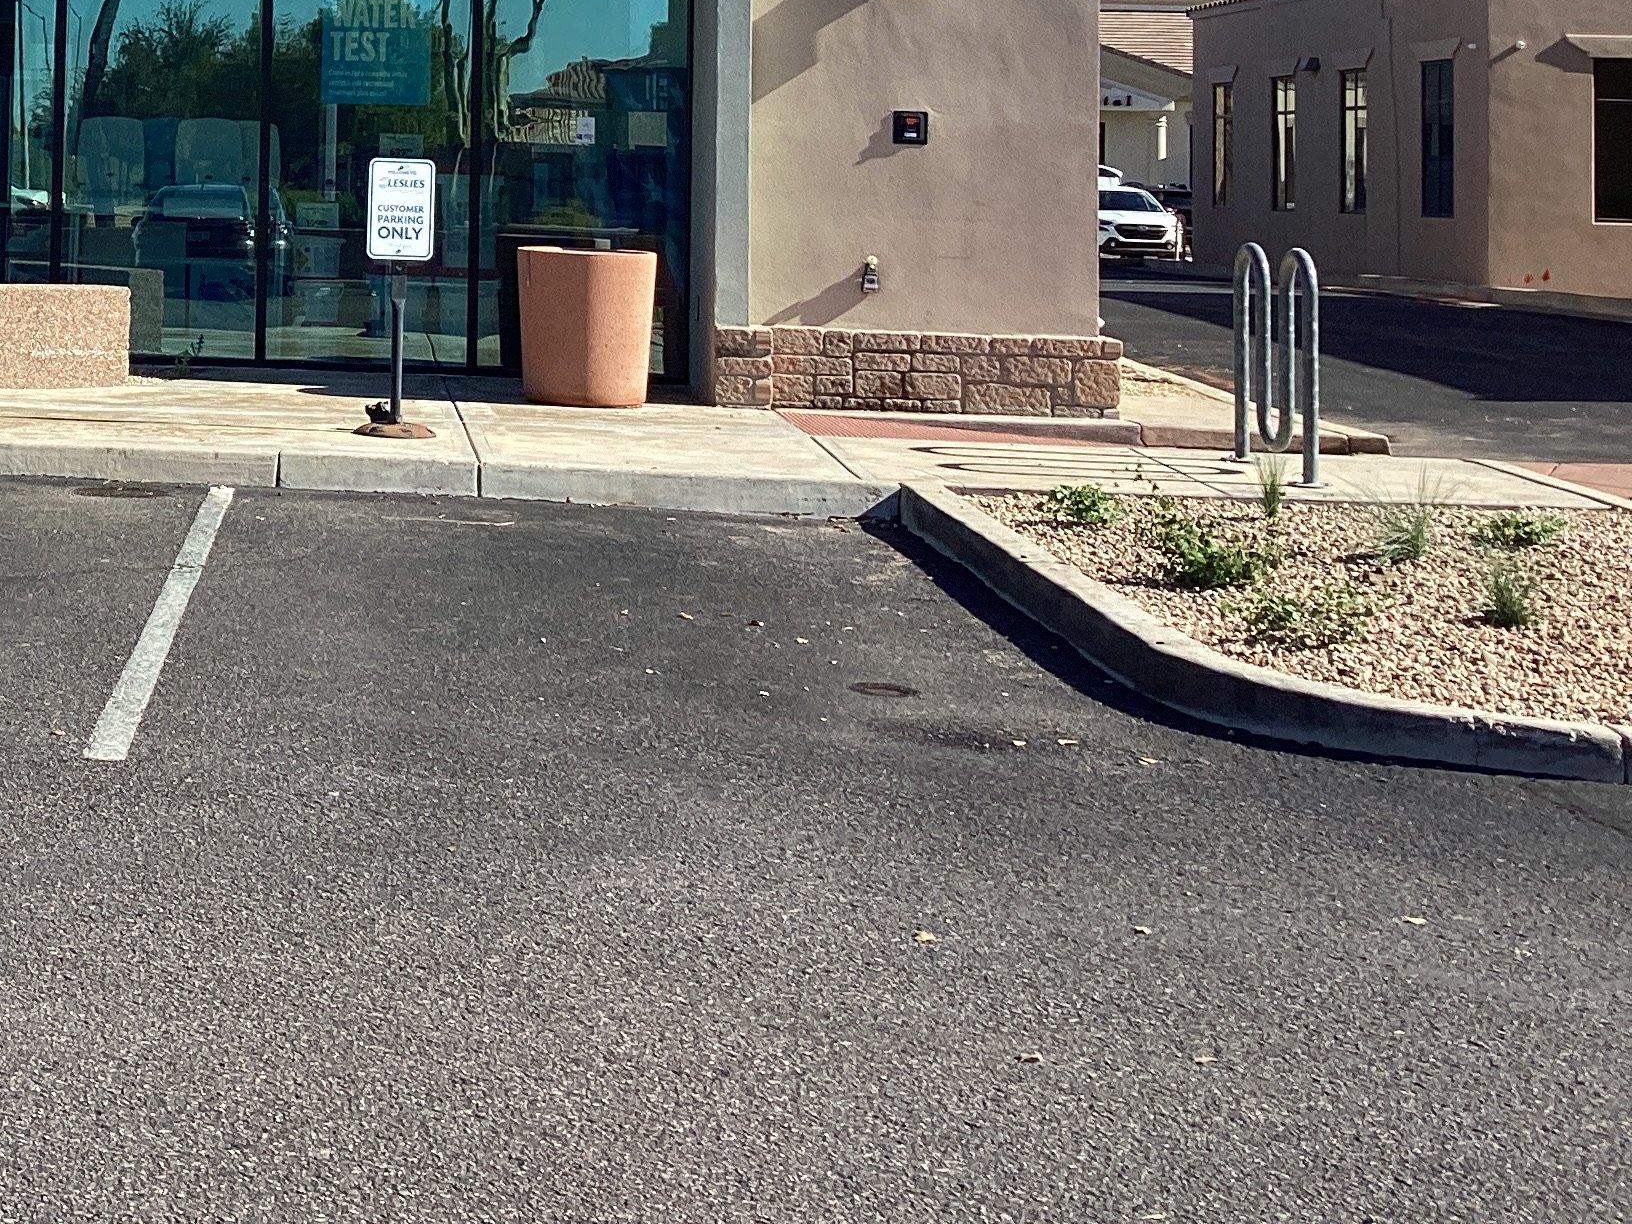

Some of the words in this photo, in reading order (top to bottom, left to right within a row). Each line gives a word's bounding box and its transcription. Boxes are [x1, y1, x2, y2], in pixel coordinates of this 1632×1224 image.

[330, 31, 390, 62] TEST
[377, 204, 424, 213] CUSTOMER
[377, 215, 424, 225] PARKING
[377, 226, 423, 240] ONLY
